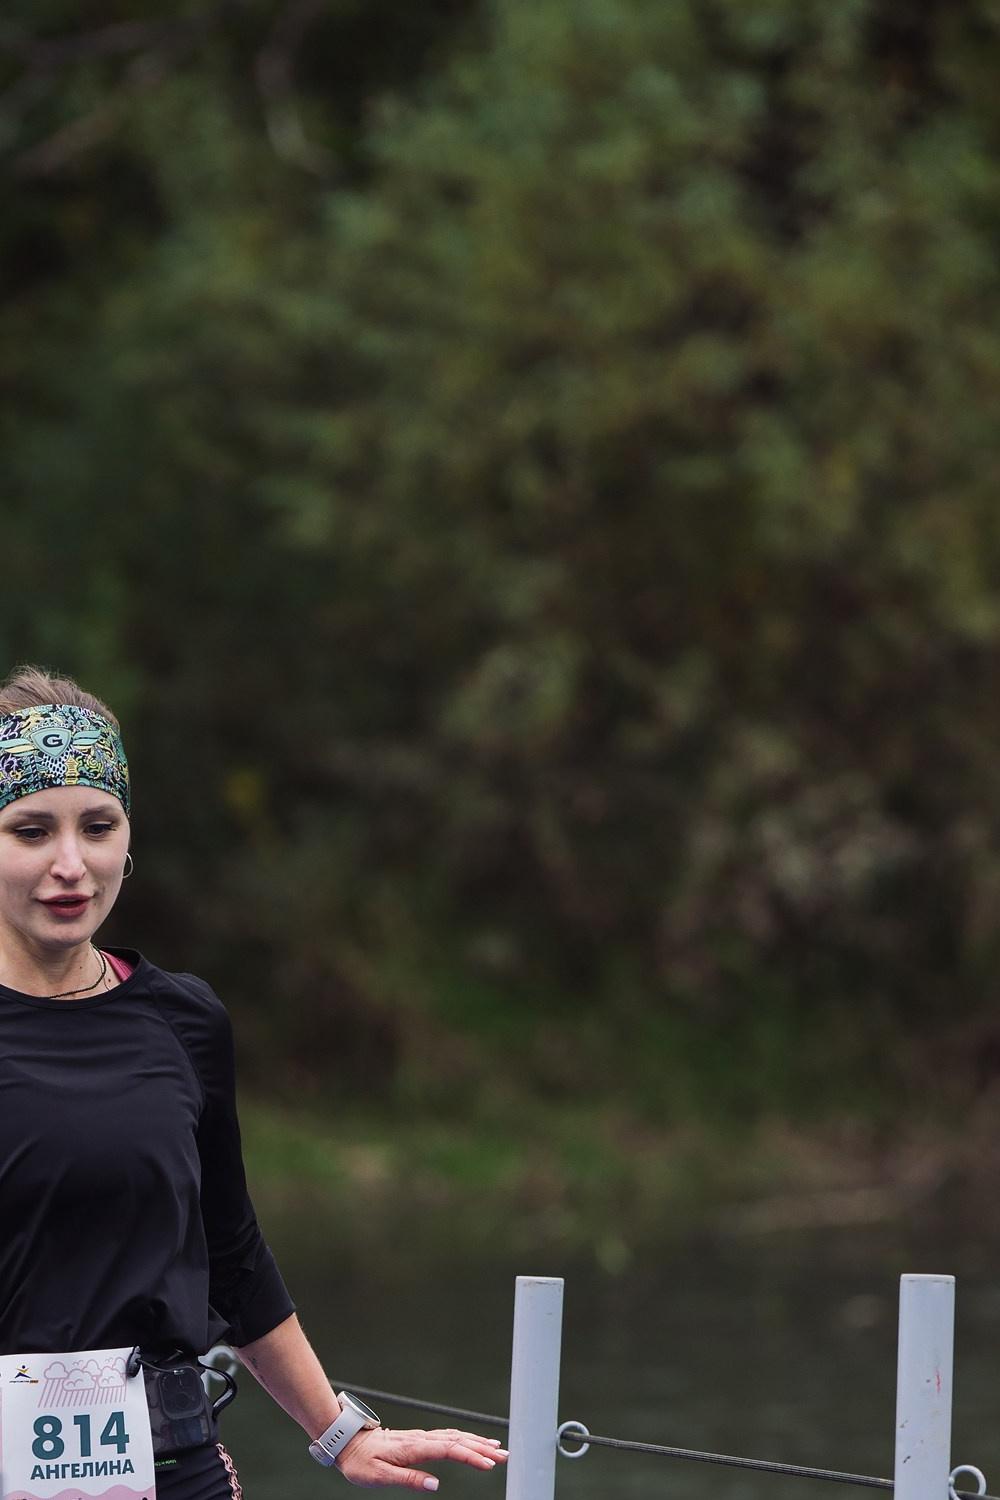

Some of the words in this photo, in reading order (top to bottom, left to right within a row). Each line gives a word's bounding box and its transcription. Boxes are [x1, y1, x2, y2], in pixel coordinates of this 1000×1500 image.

[42, 733, 63, 747] G
[31, 1411, 130, 1461] 814
[30, 1459, 135, 1480] АНГЕЛИНА
